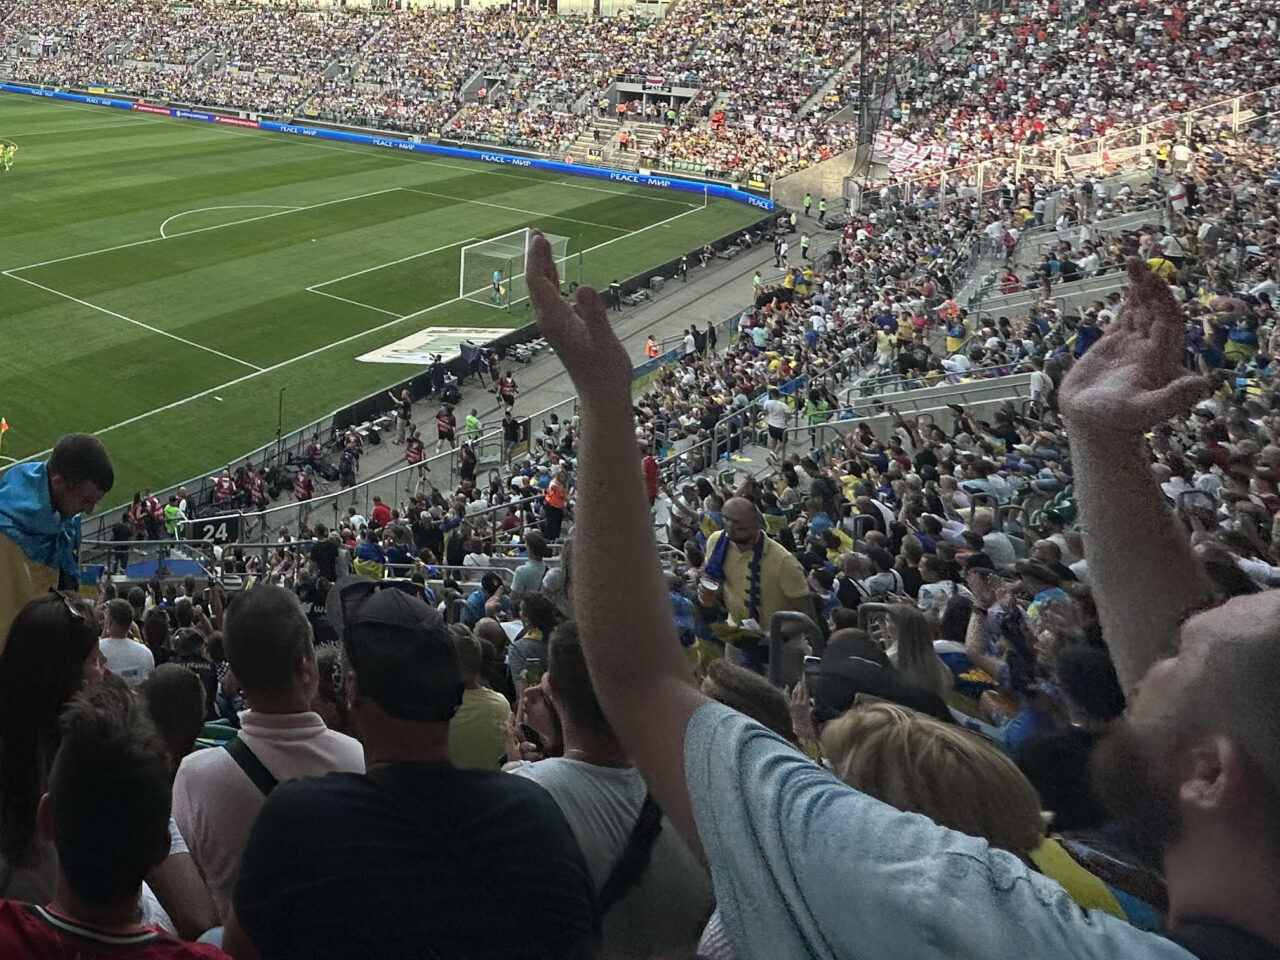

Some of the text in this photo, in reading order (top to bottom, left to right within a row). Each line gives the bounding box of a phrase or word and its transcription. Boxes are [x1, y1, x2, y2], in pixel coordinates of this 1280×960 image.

[480, 154, 505, 163] PEACE
[610, 172, 639, 183] PEACE
[647, 178, 670, 187] МИР
[748, 196, 770, 210] PEACE
[202, 522, 228, 543] 24
